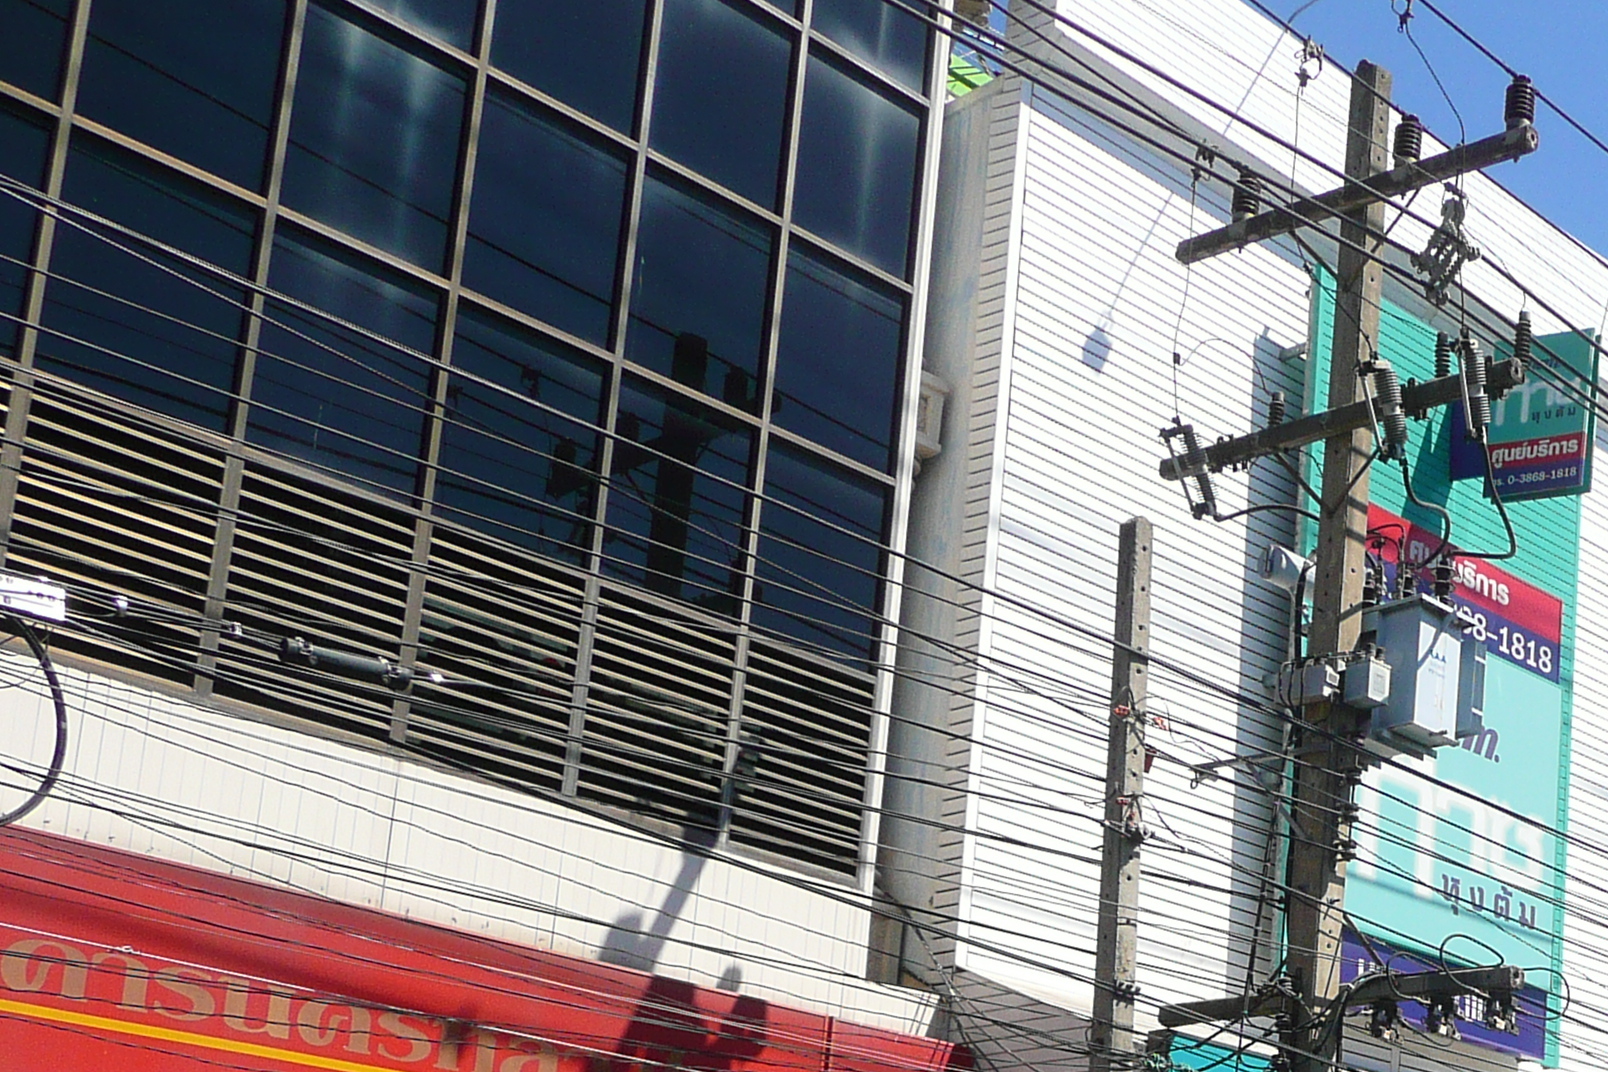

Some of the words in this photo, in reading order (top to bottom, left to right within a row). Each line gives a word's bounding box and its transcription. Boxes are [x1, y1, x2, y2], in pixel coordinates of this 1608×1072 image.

[1491, 438, 1579, 469] ศูนย์บริการ
[1507, 466, 1577, 485] 0-3868-1818
